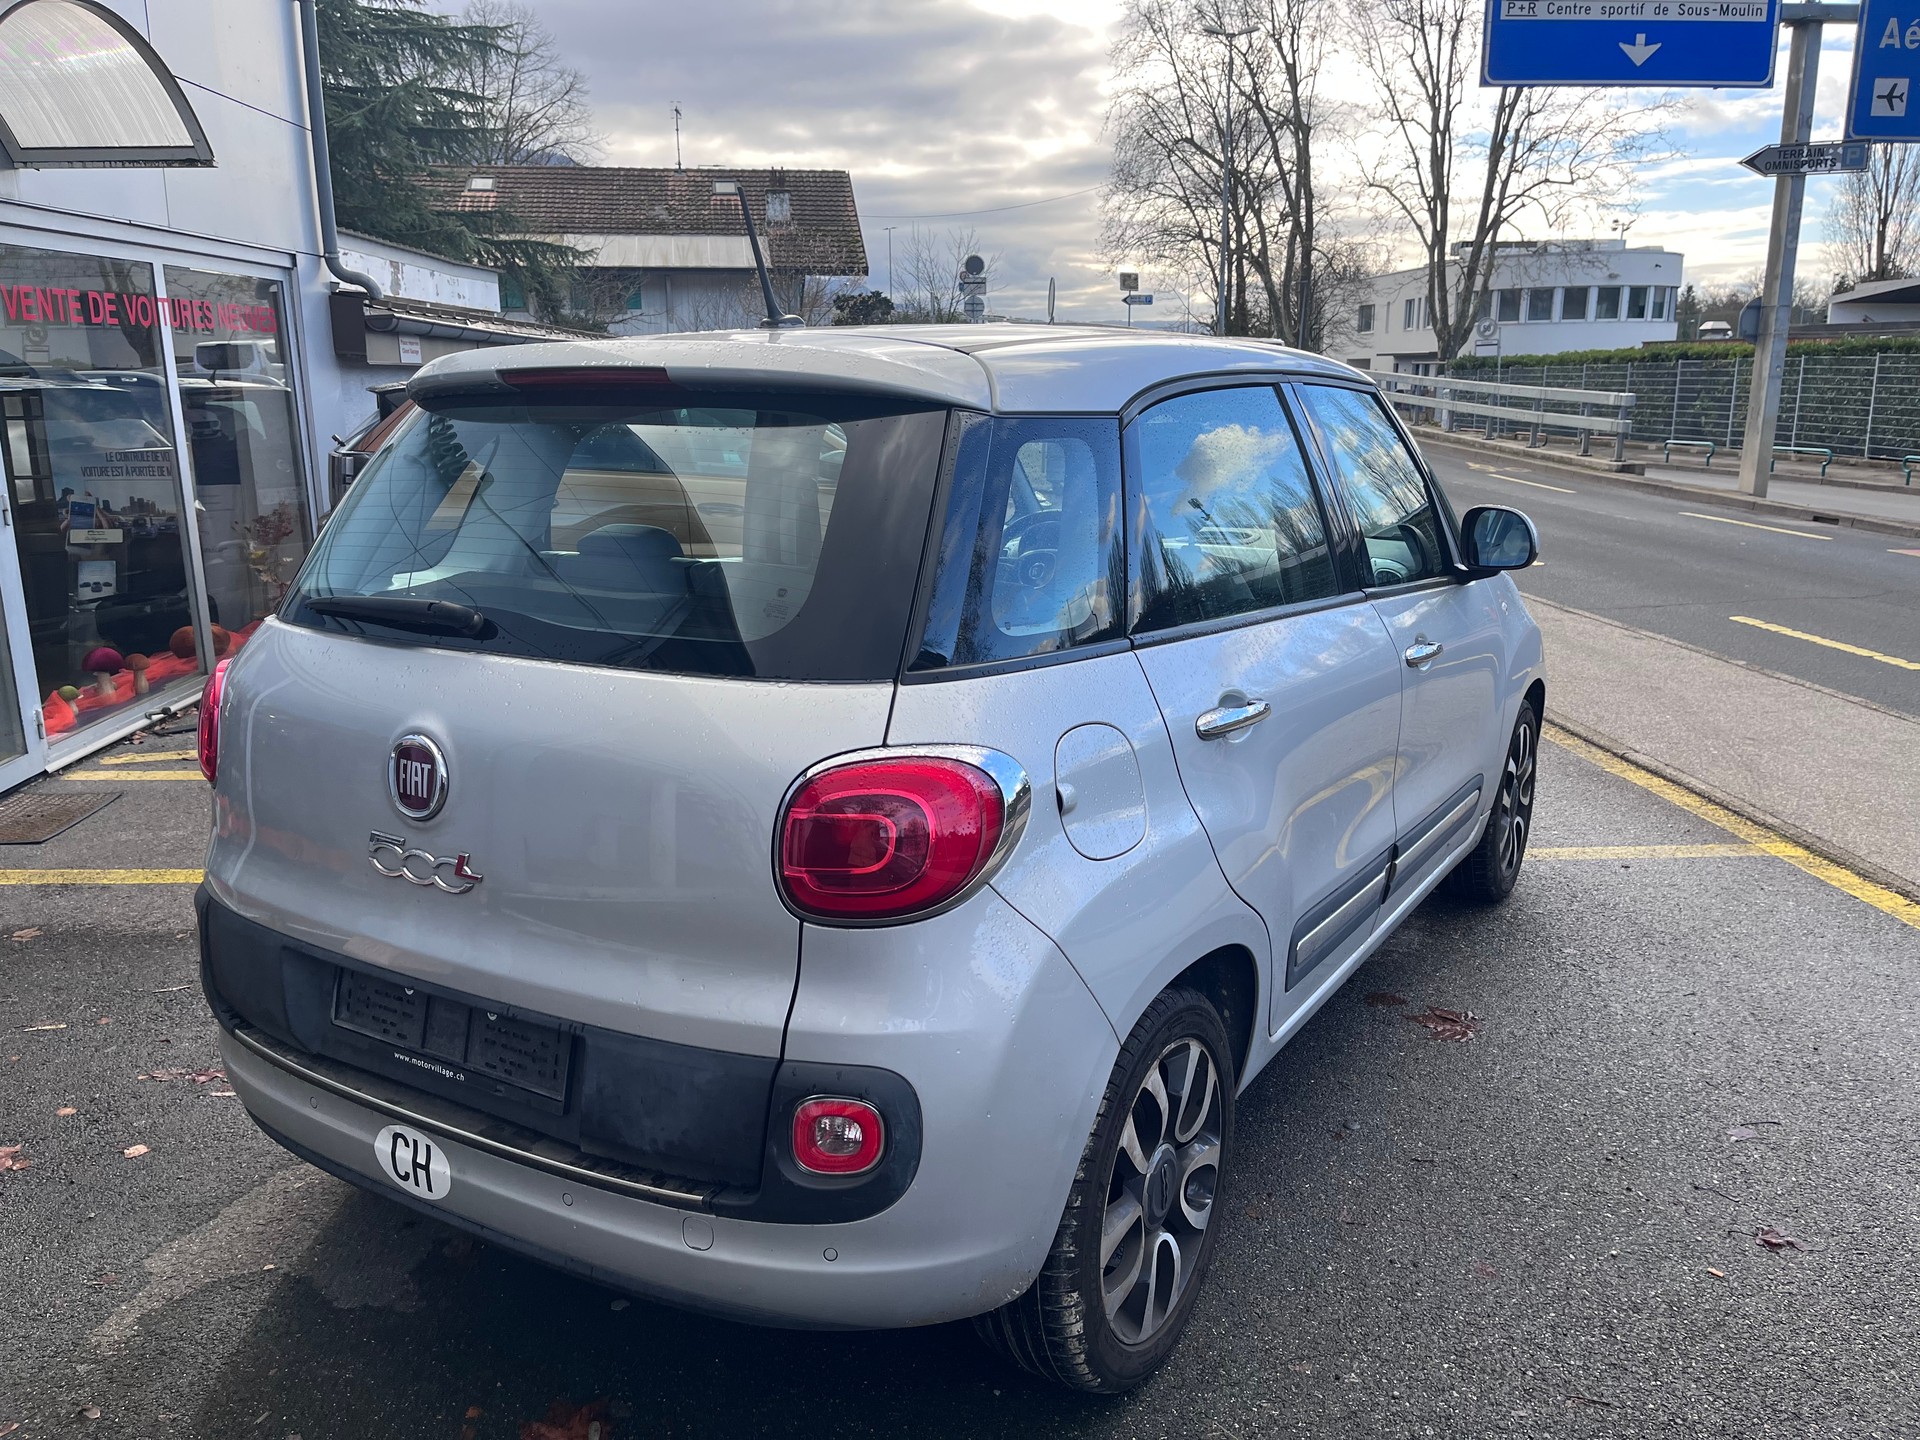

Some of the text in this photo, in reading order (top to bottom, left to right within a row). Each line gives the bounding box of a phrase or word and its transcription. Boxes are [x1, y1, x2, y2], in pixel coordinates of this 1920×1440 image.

[1506, 2, 1763, 19] P+R Centre sportif de Sous-Moulin
[1764, 157, 1837, 171] OMNISPORTS
[1777, 147, 1825, 159] TERRAIN
[0, 284, 277, 333] VENTE DE VOITURES NEUVES
[81, 466, 110, 477] VOITURE
[111, 466, 124, 477] EST
[400, 758, 432, 799] FIAT
[393, 1051, 465, 1082] www.motorvillage.ch
[390, 1131, 434, 1194] CH
